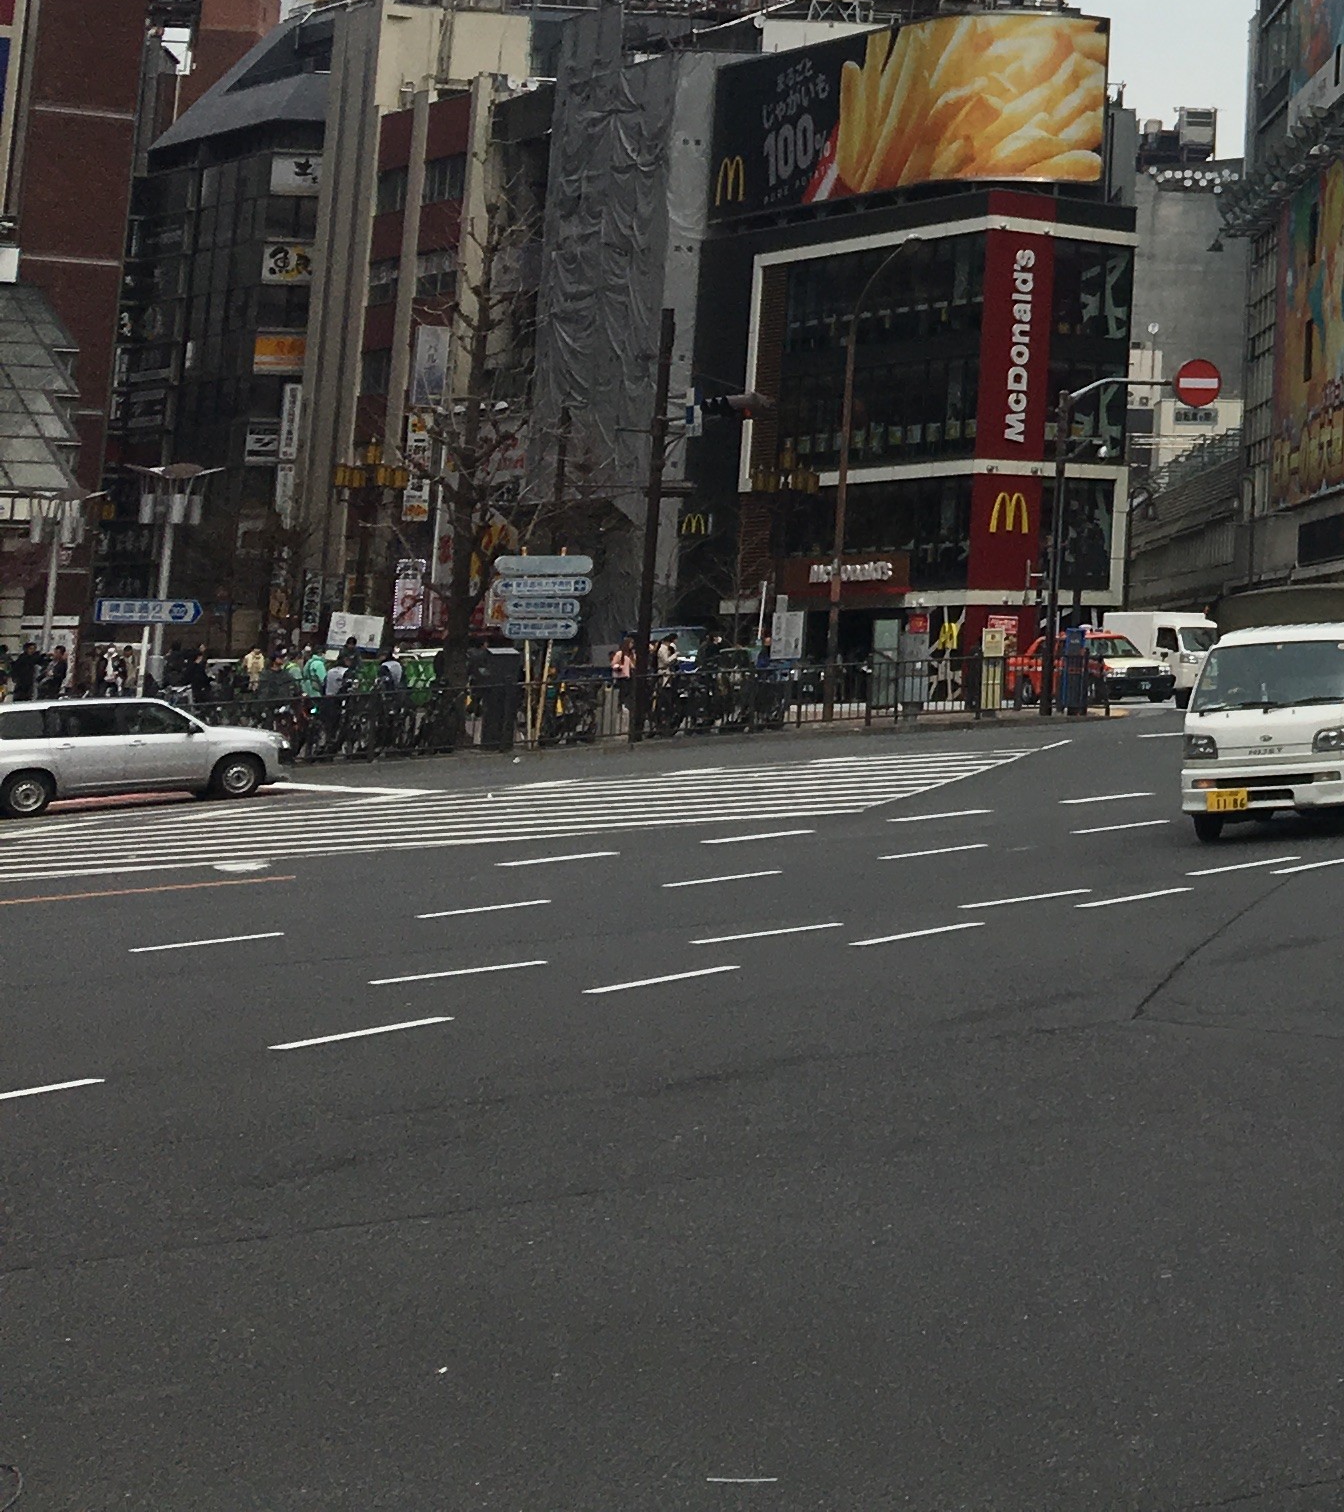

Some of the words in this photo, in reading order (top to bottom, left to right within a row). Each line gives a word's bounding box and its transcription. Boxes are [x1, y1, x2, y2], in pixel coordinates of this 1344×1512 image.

[762, 72, 830, 130] じゃがいも
[763, 113, 831, 187] 100%
[1004, 247, 1036, 444] McDonald's
